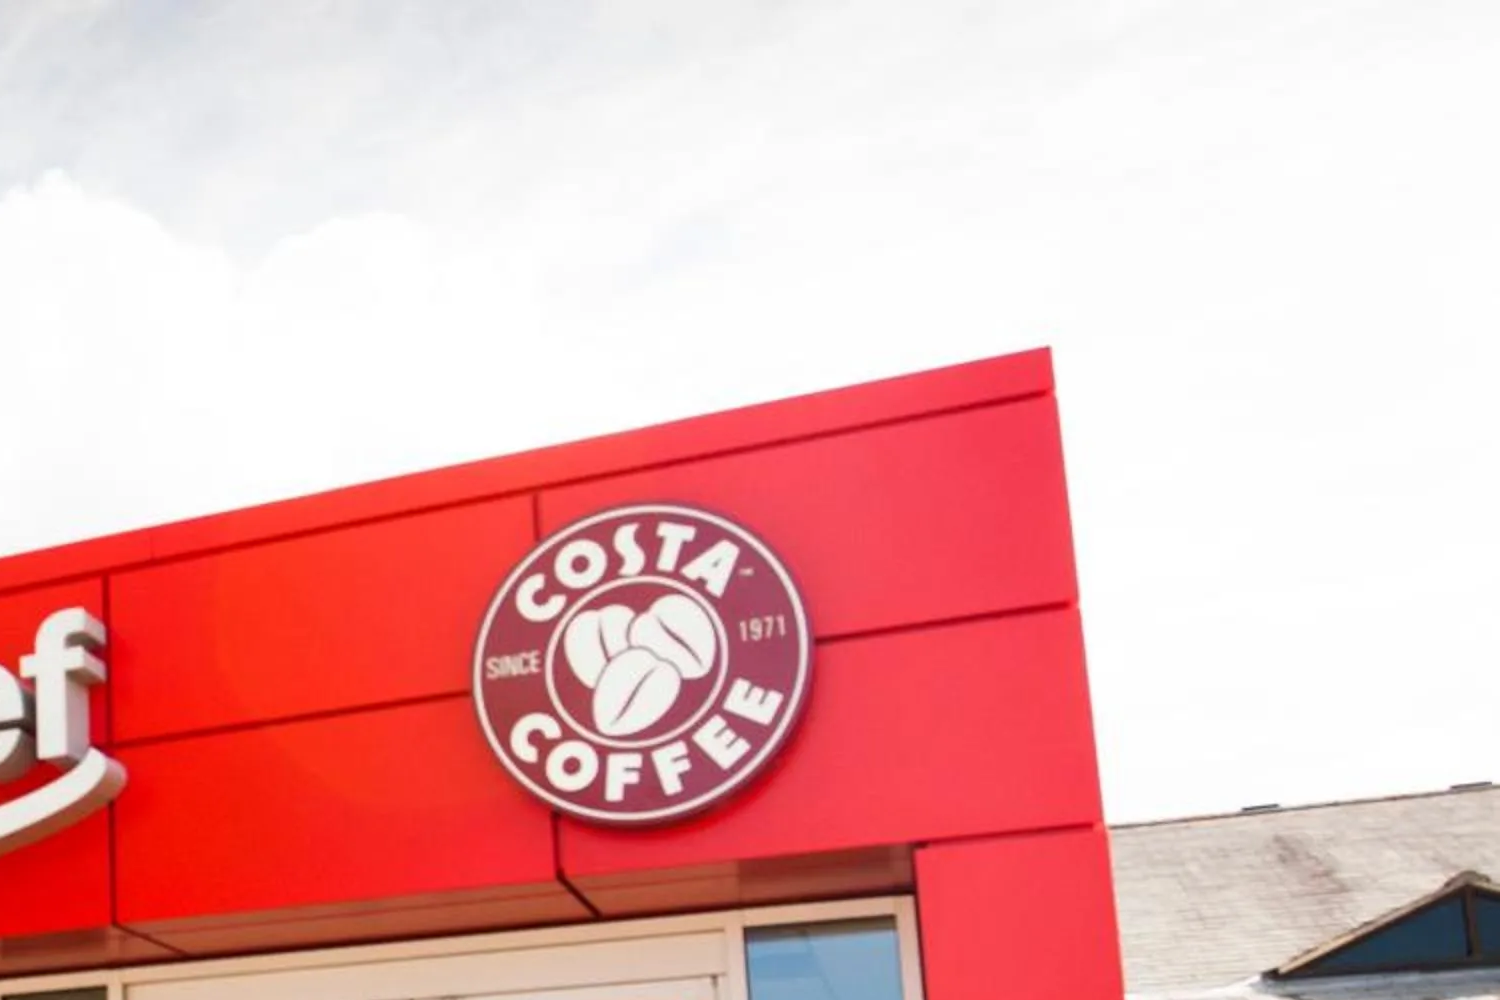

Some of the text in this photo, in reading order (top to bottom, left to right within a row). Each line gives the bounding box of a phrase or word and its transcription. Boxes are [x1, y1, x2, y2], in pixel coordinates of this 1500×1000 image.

[514, 520, 740, 622] COSTA
[485, 614, 787, 680] SINCE 1971
[509, 677, 785, 802] COFFEE
